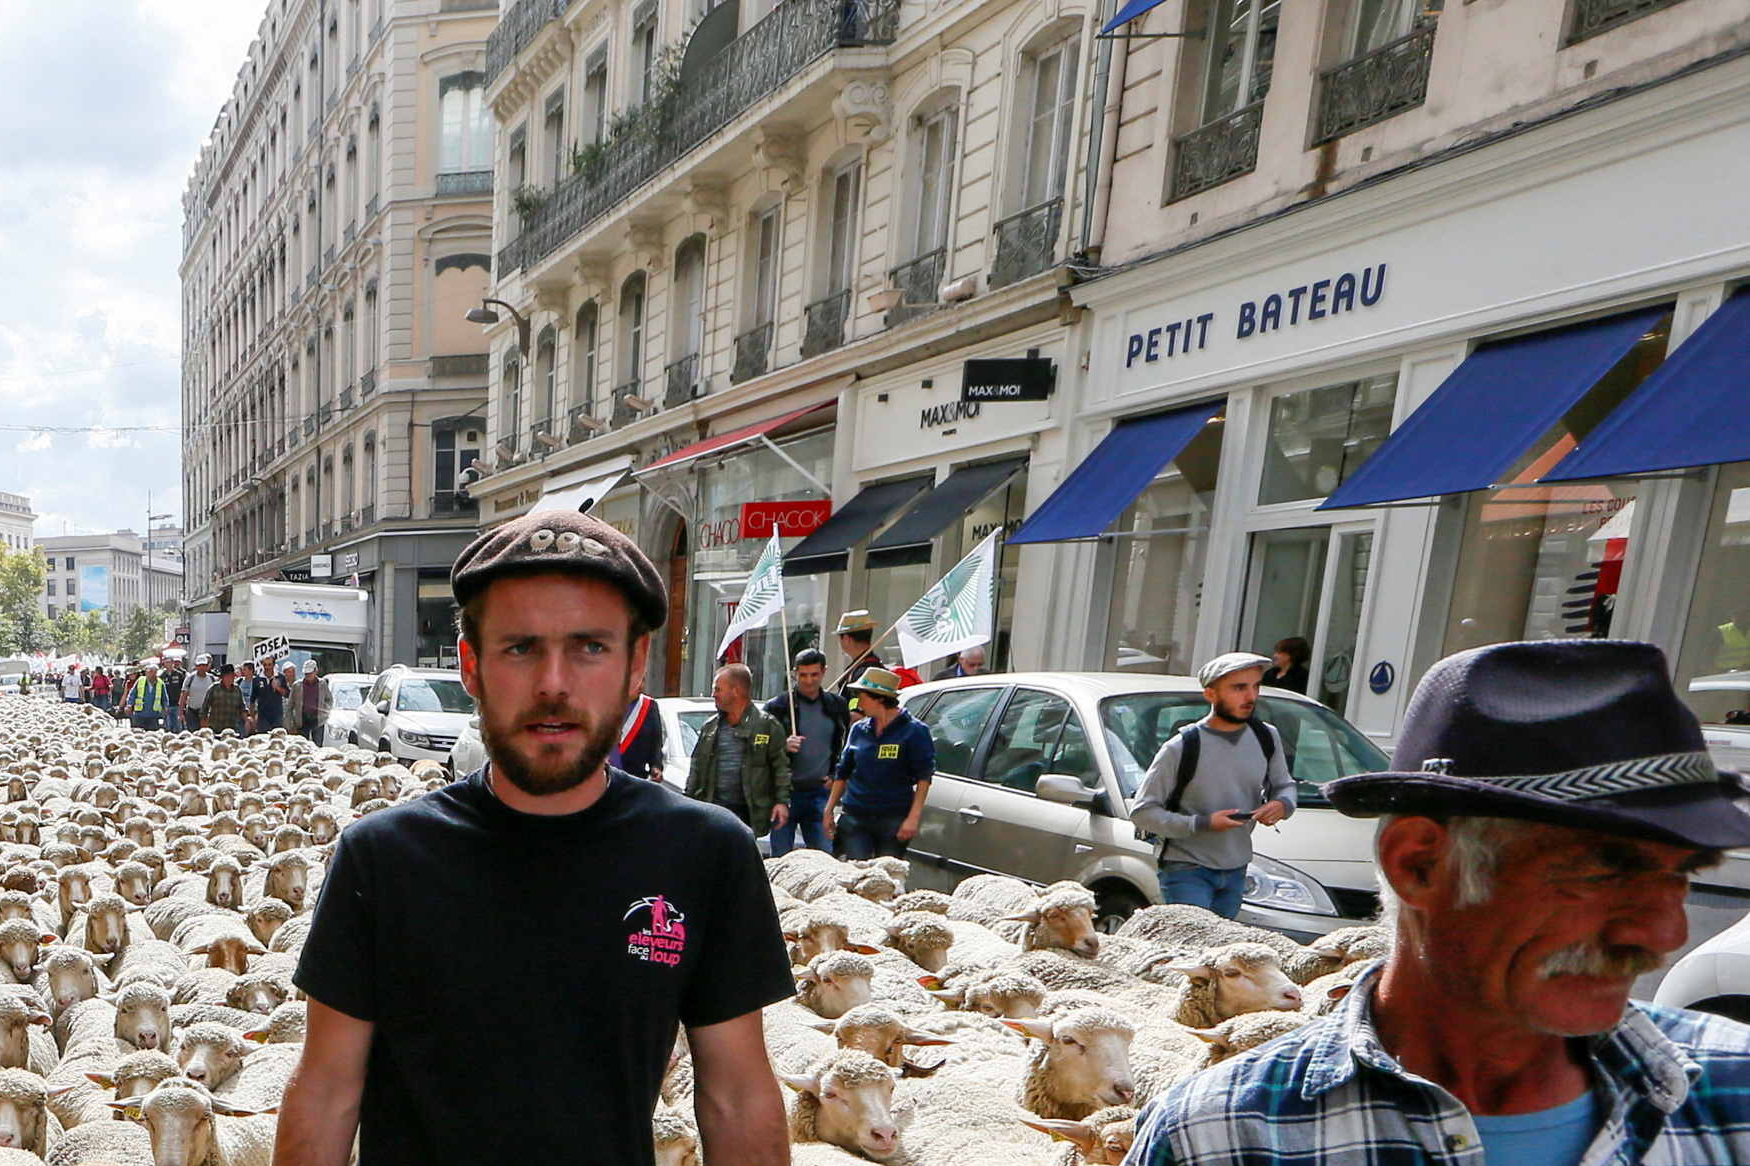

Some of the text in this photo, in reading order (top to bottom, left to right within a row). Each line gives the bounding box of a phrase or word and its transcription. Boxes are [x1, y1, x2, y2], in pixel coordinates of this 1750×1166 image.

[1126, 263, 1387, 368] PETIT BATEAU
[968, 384, 1021, 396] MAX&MOI
[920, 400, 981, 429] MAX&MOI
[1582, 501, 1603, 515] LES
[748, 509, 826, 529] CHACOK
[700, 517, 741, 549] CHACO
[175, 634, 190, 644] OL
[253, 634, 288, 659] FDSEA
[628, 931, 684, 951] eleveurs
[642, 928, 652, 936] les
[627, 943, 650, 956] face
[650, 946, 681, 968] loup
